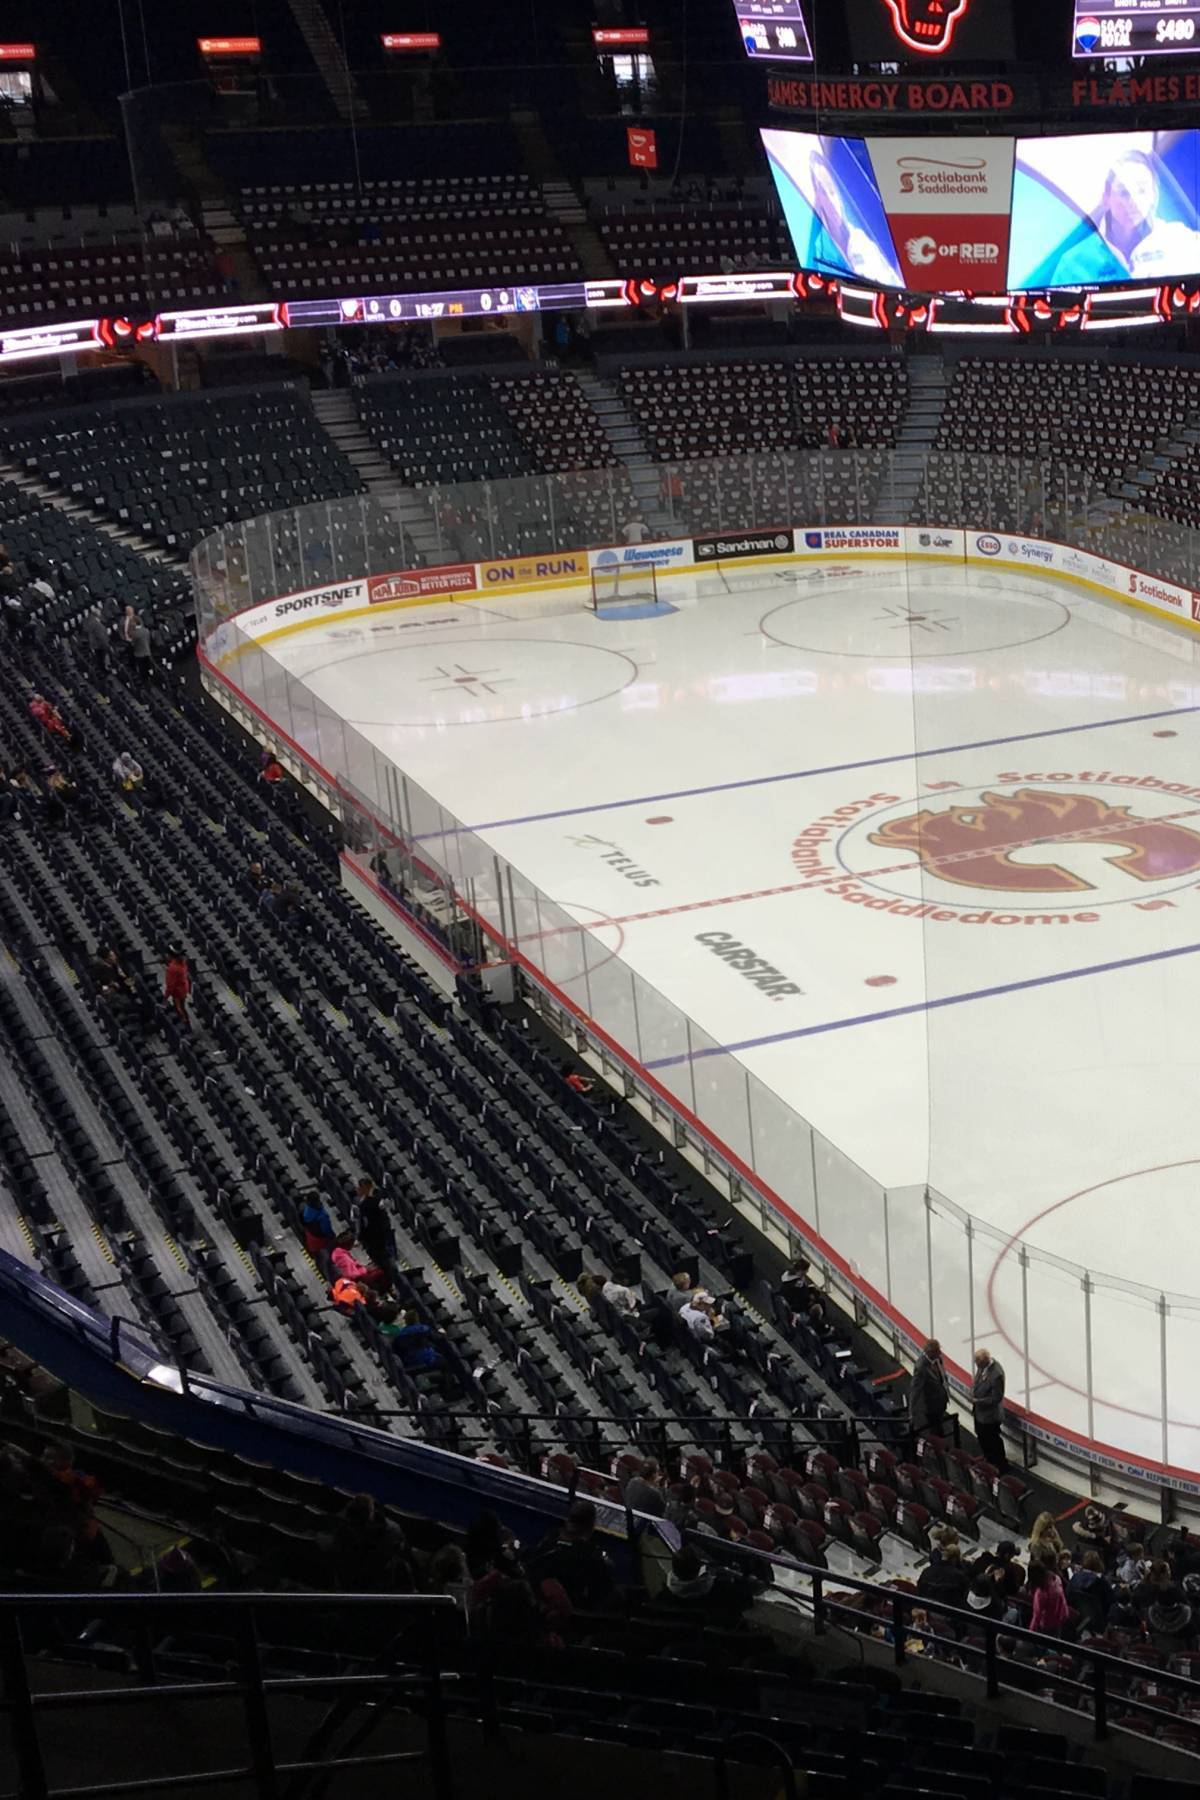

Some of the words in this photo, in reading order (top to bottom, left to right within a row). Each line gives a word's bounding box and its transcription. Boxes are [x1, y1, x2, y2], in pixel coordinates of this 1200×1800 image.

[1100, 19, 1133, 33] 50/50
[1156, 19, 1195, 43] $480
[810, 81, 900, 109] ENERGY
[908, 83, 1014, 110] BOARD
[1072, 77, 1179, 106] FLAMES
[917, 172, 985, 183] Scotiabank
[918, 184, 988, 195] Saddledome
[938, 247, 958, 258] OF
[960, 243, 999, 258] RED
[824, 531, 842, 539] REAL
[843, 530, 899, 538] CANADIAN
[824, 539, 899, 549] SUPERSTORE
[624, 545, 683, 561] Wawanesa
[716, 540, 774, 554] Sandman
[1021, 545, 1054, 562] Synergy
[486, 567, 514, 582] ON
[536, 559, 576, 576] RUN
[275, 585, 363, 617] SPORTSNET
[1139, 582, 1183, 607] Scotiabank
[791, 791, 901, 880] Scotiabank
[600, 850, 662, 888] TELUS
[823, 881, 1102, 926] Saddledome
[694, 931, 802, 998] CARSTAR
